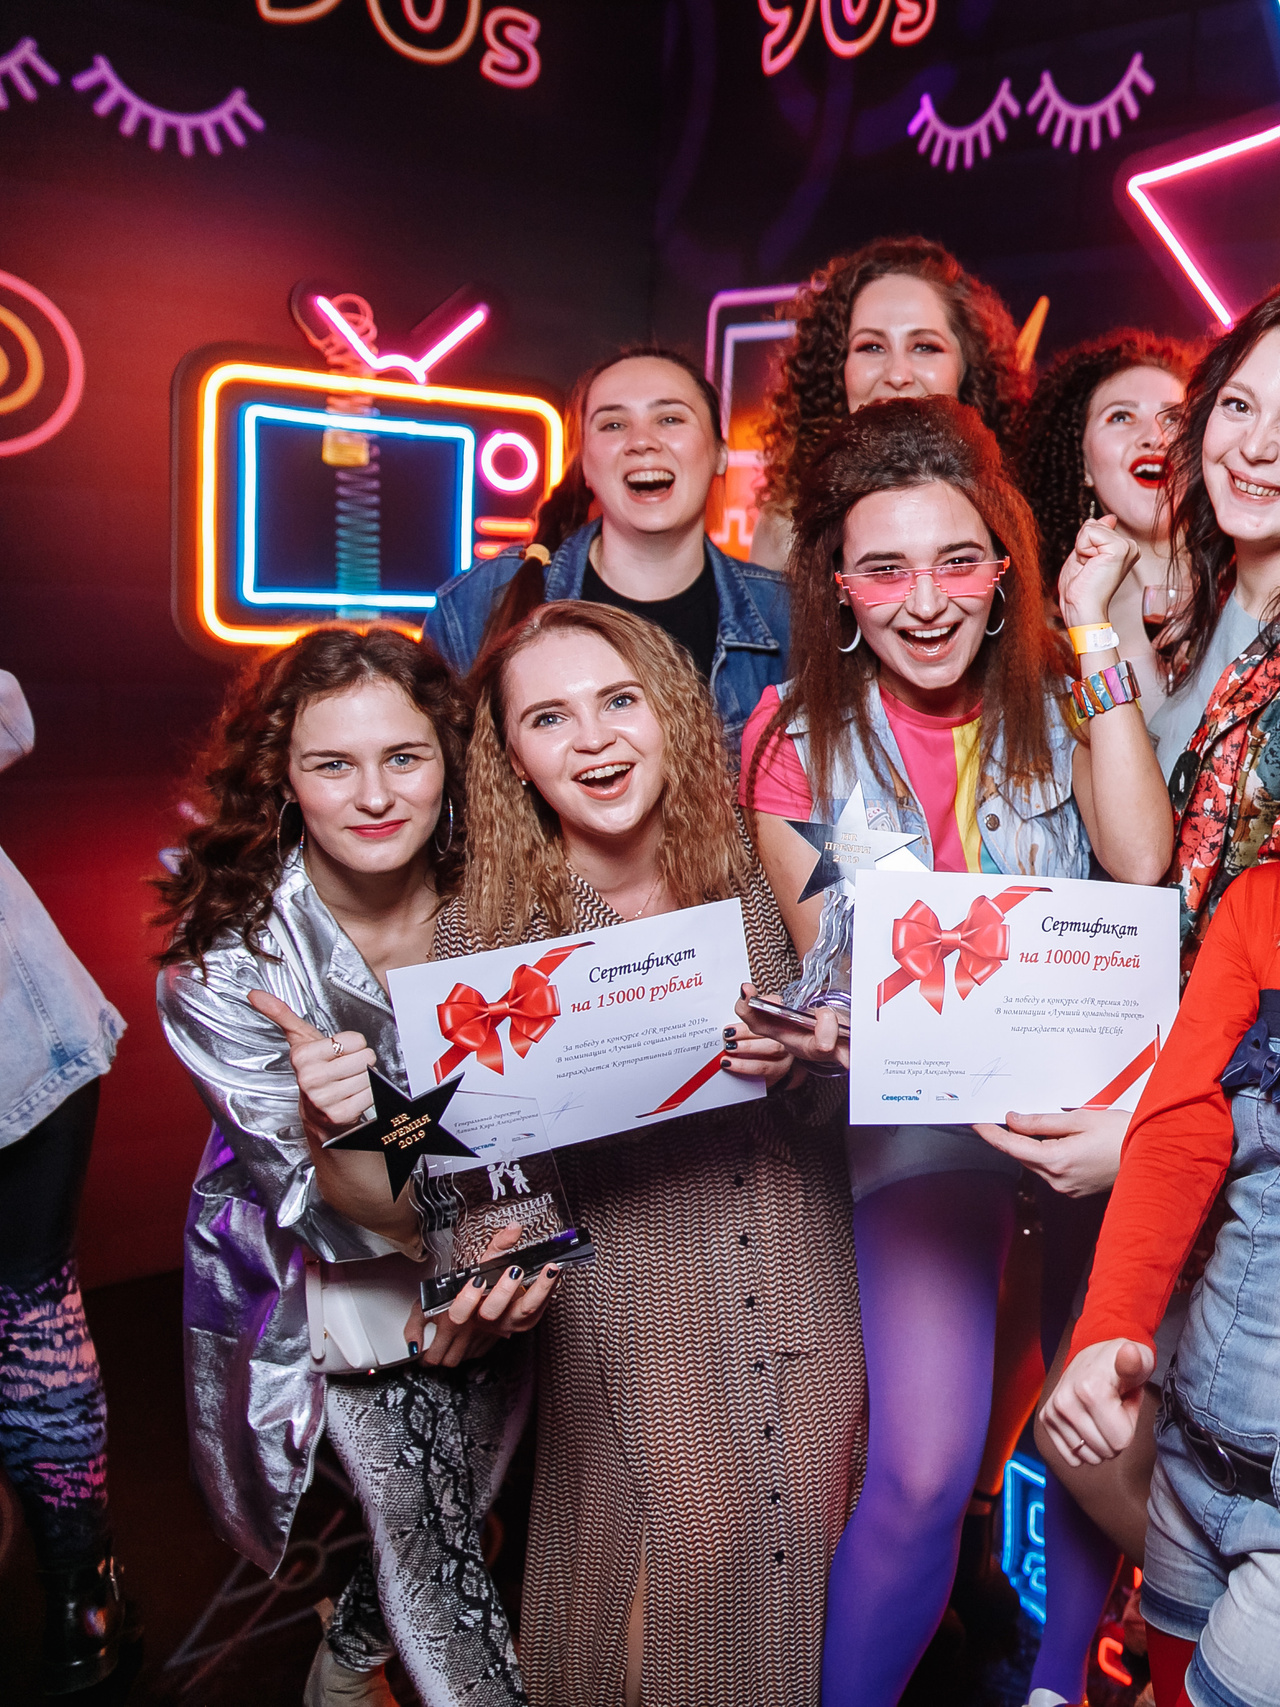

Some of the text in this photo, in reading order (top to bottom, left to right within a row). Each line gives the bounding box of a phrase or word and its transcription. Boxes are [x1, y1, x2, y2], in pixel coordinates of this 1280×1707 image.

[1041, 916, 1138, 939] Сертификат
[589, 948, 696, 983] Сертификат
[1019, 949, 1140, 971] на 10000 рублей
[571, 972, 704, 1013] на 15000 рублей
[1003, 996, 1013, 1004] За
[1014, 995, 1040, 1006] победу
[1047, 997, 1079, 1007] конкурсе
[1003, 1009, 1046, 1018] номинации
[1082, 1010, 1120, 1020] командный
[563, 1045, 573, 1053] За
[574, 1037, 601, 1051] победу
[607, 1032, 640, 1045] конкурсе
[659, 1023, 687, 1034] премия
[1011, 1024, 1065, 1035] награждается
[1066, 1026, 1097, 1035] команда
[564, 1050, 607, 1062] номинации
[609, 1041, 642, 1054] «Лучший
[643, 1032, 687, 1047] социальный
[688, 1027, 719, 1039] проект»
[556, 1063, 610, 1079] награждается
[611, 1049, 673, 1069] Корпоративный
[673, 1044, 701, 1055] Театр
[884, 1059, 951, 1067] Генеральный директор
[881, 1094, 920, 1102] Северсталь
[381, 1114, 431, 1145] ПРЕМИЯ
[390, 1113, 411, 1127] HR
[398, 1130, 426, 1149] 2019
